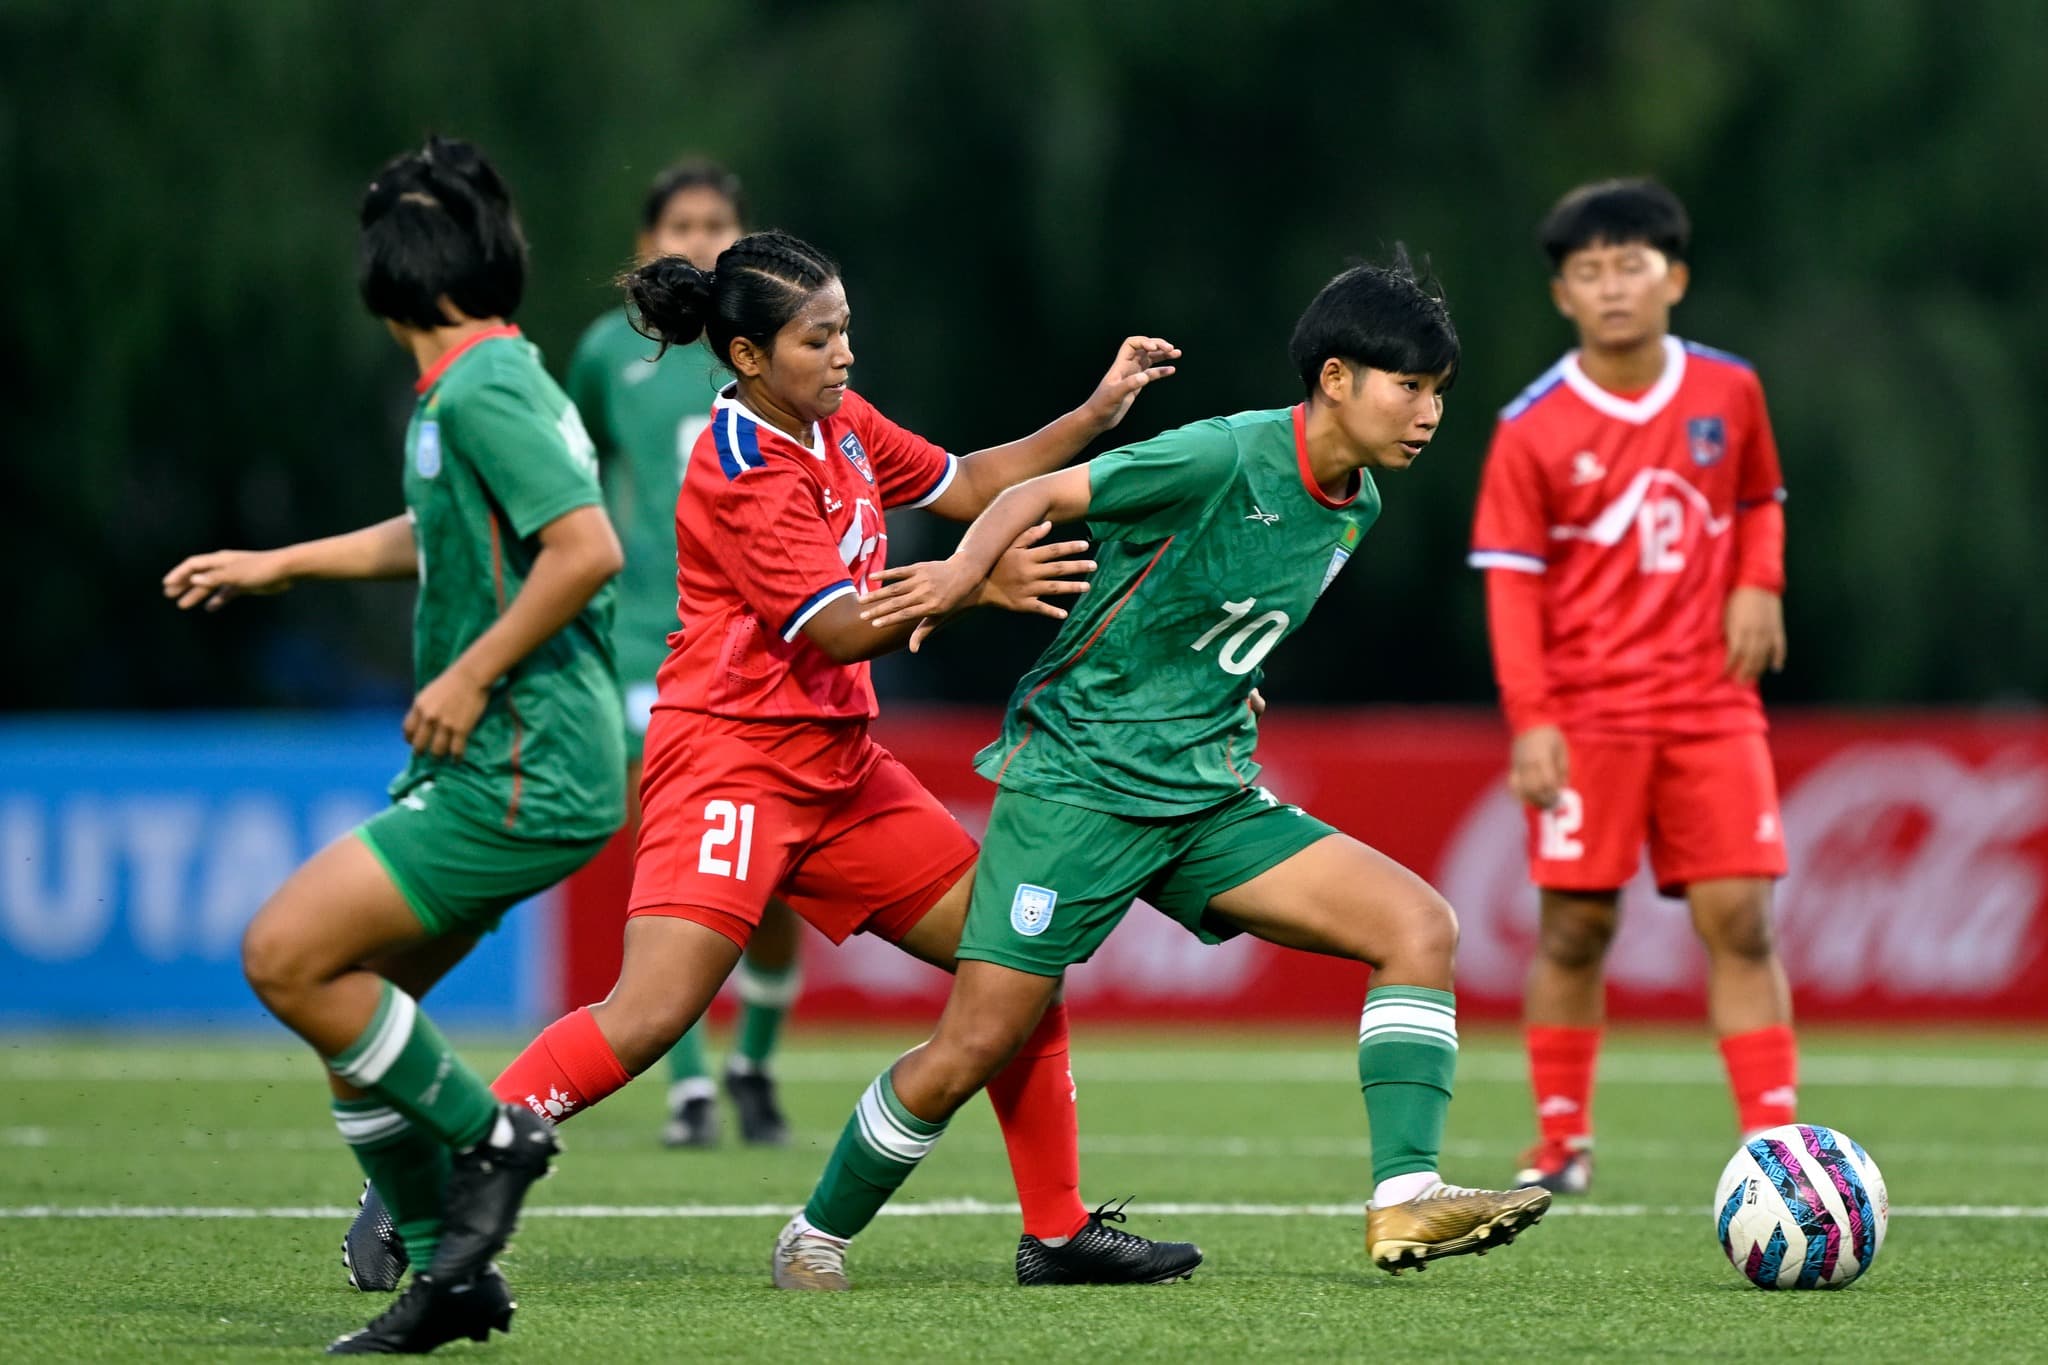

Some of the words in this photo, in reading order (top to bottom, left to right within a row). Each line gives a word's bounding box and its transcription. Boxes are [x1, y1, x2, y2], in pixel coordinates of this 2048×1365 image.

[1637, 498, 1685, 573] 12
[1191, 597, 1290, 675] 10
[698, 800, 755, 881] 21
